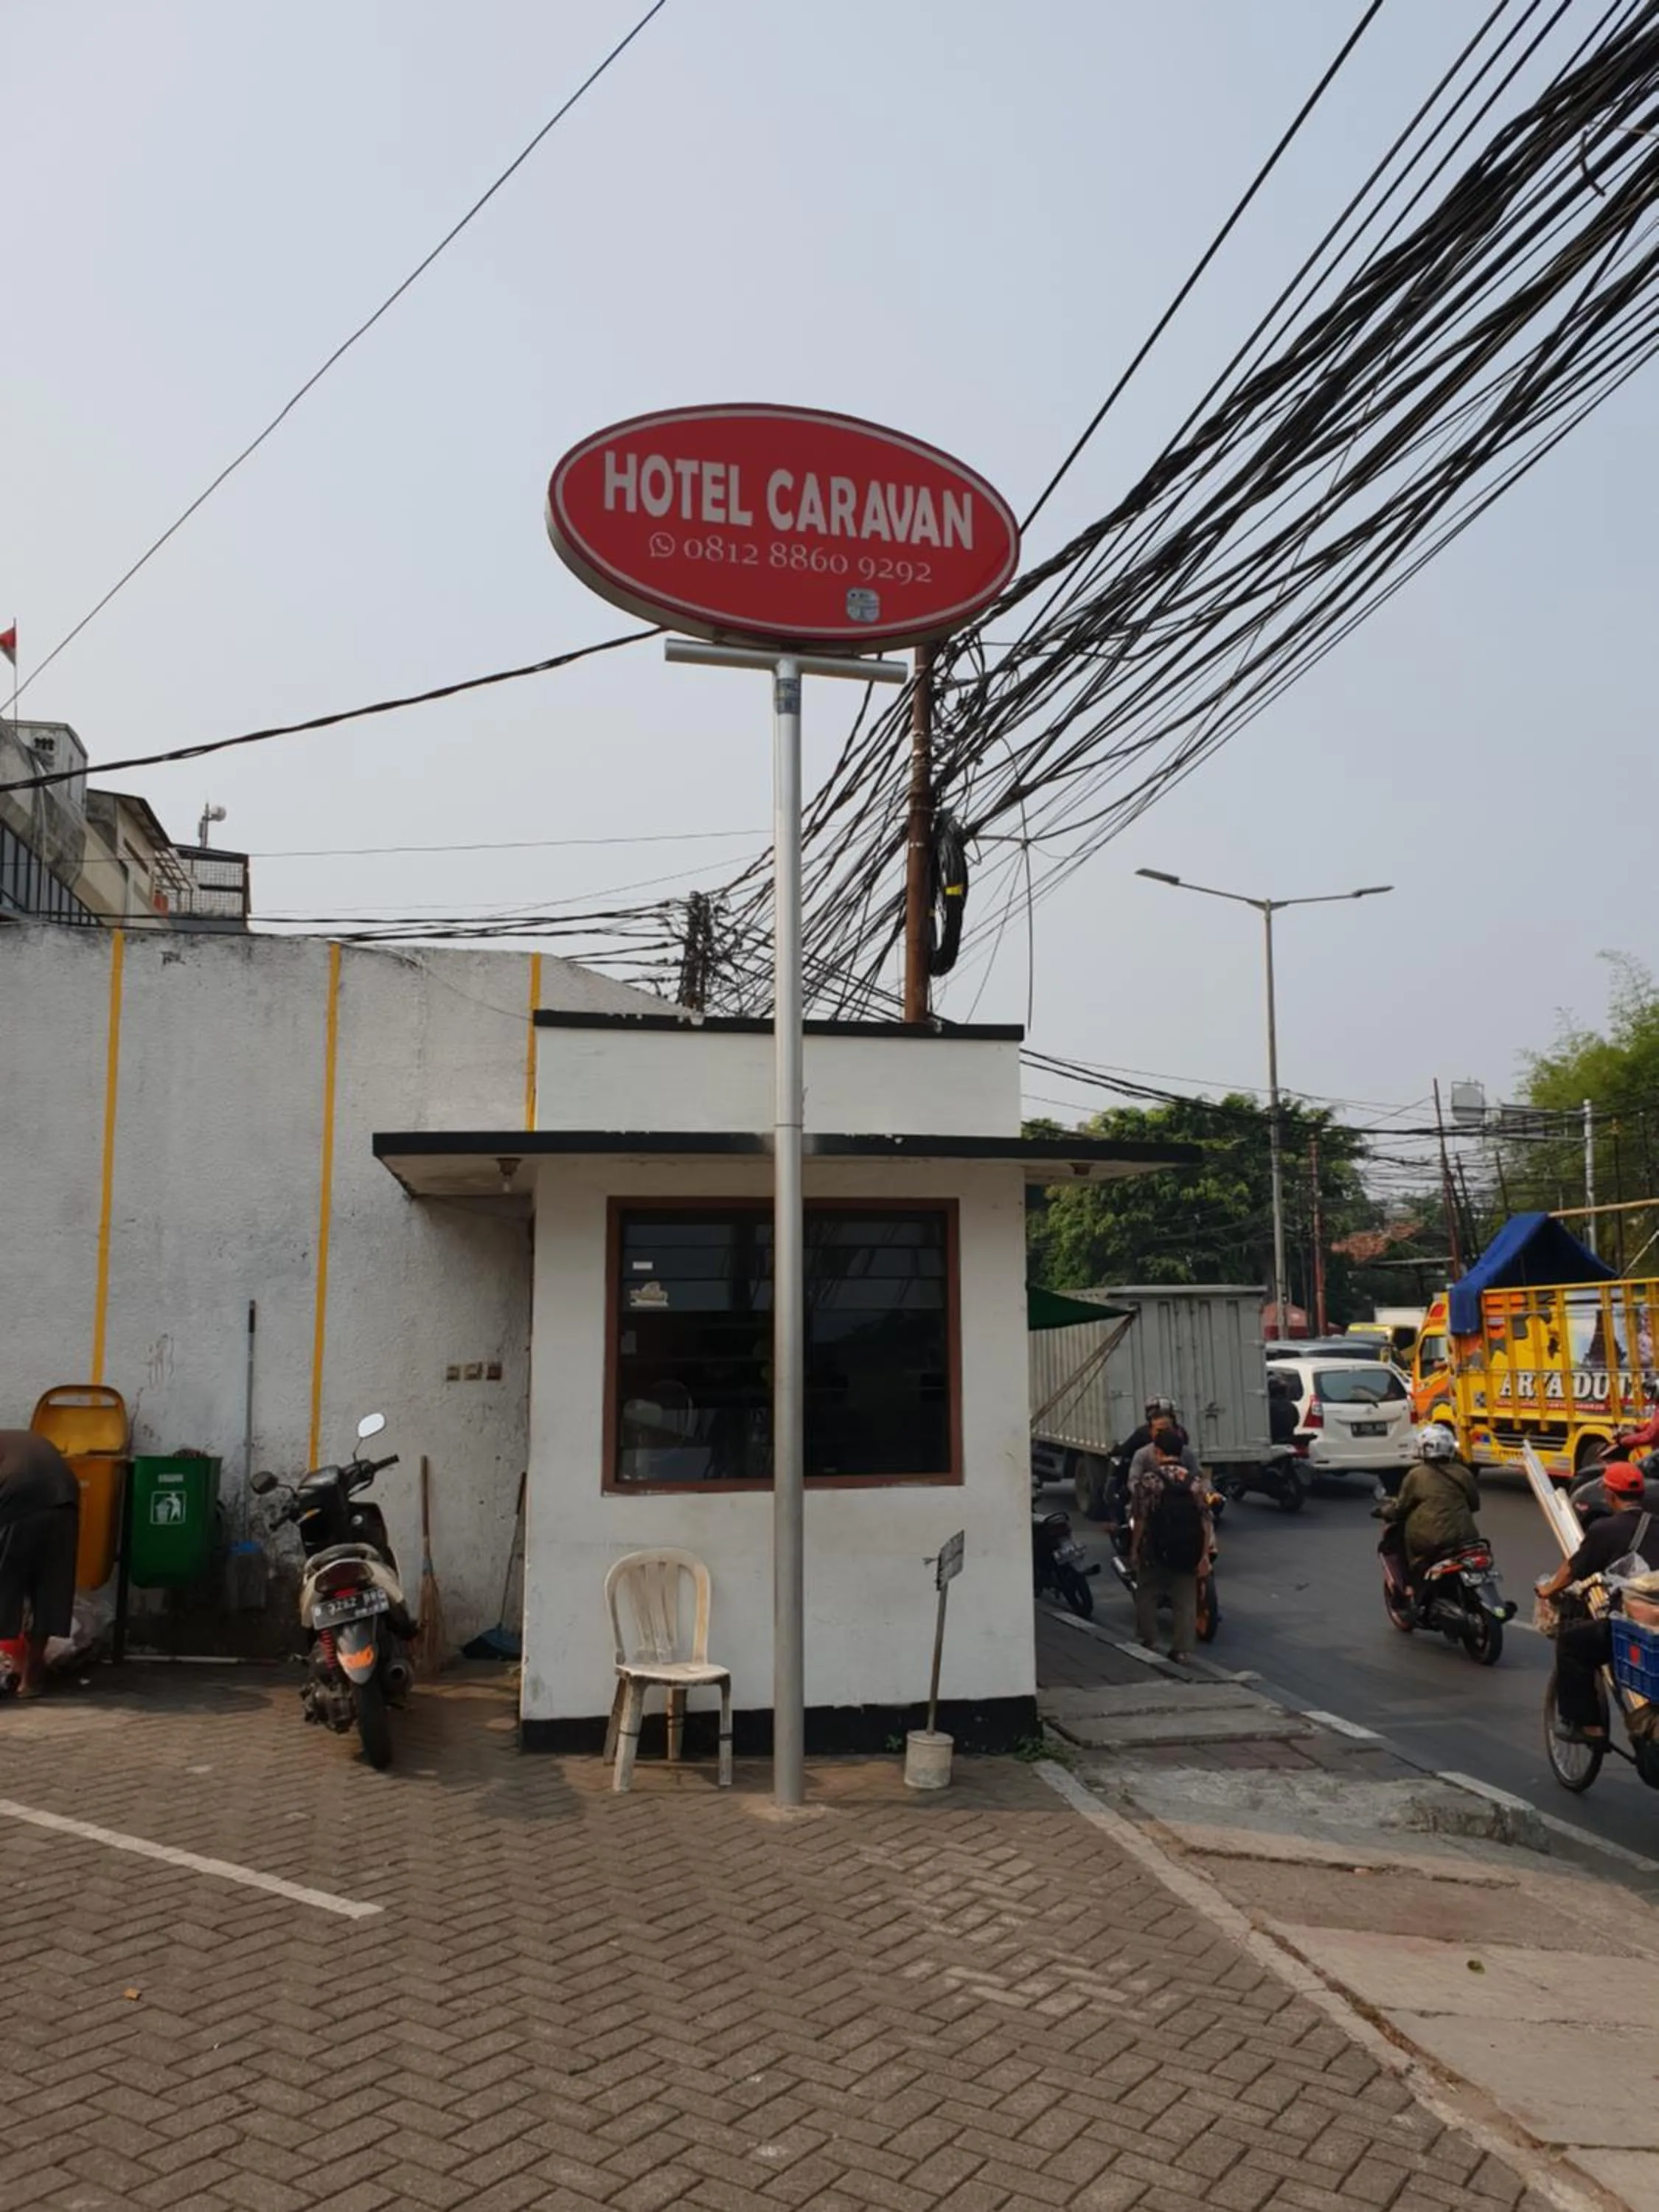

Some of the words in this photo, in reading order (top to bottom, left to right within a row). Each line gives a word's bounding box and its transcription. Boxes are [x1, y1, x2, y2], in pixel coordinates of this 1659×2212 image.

[604, 451, 753, 526] HOTEL
[767, 468, 973, 550] CARAVAN
[683, 535, 759, 566] 0812
[769, 542, 848, 574] 8860
[858, 556, 933, 585] 9292
